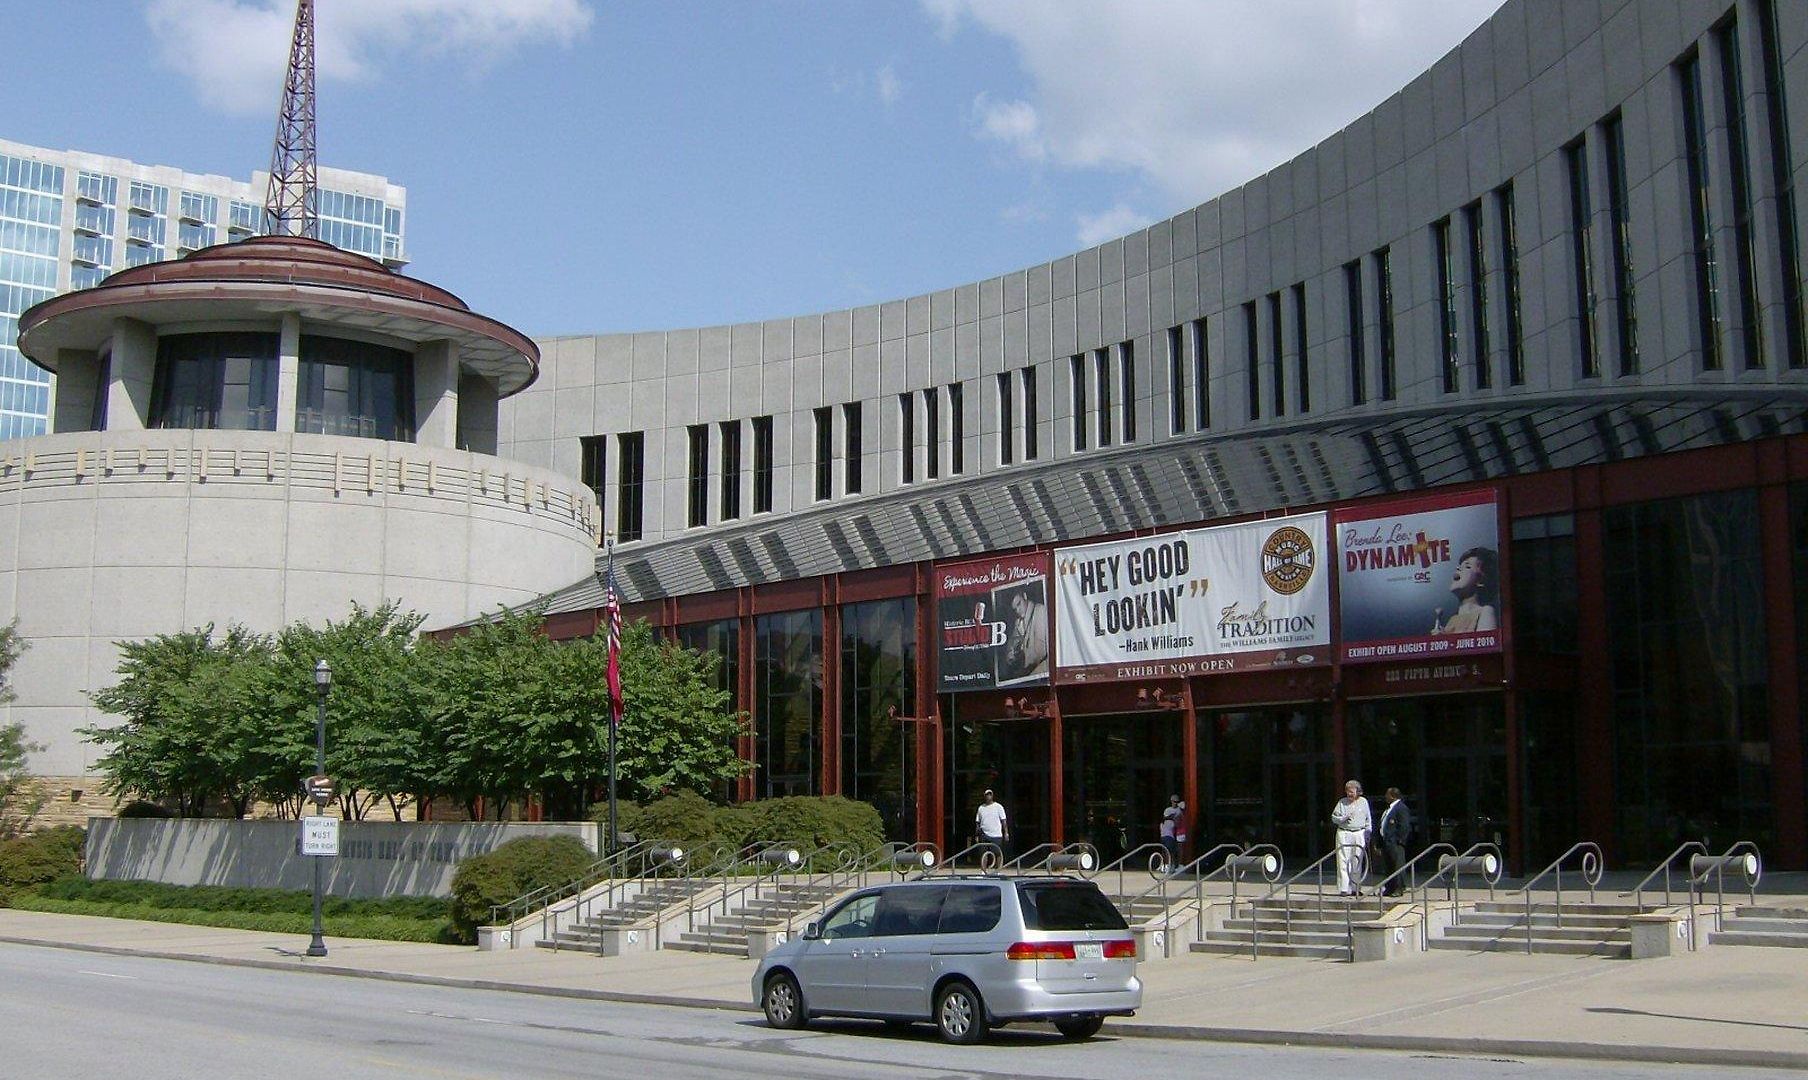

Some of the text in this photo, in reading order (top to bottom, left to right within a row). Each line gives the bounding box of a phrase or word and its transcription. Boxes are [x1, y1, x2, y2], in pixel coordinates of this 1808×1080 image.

[1275, 541, 1301, 554] MUSIC
[1345, 529, 1383, 548] Brenda
[1345, 531, 1451, 573] DYNAMITE
[1127, 540, 1189, 587] GOOD
[943, 563, 1039, 592] Experience the Magic
[990, 621, 1007, 646] B
[1220, 615, 1315, 639] TRADITION
[1151, 636, 1194, 652] Williams
[1232, 637, 1267, 648] WILLIAMS
[1349, 647, 1375, 659] EXHIBIT
[1377, 645, 1396, 657] OPEN
[1398, 641, 1428, 655] AUGUST
[1430, 640, 1449, 652] 2009
[1456, 638, 1475, 650] JUNE
[1477, 636, 1495, 648] 2010
[1117, 665, 1165, 679] EXHIBIT
[1170, 662, 1196, 676] NOW
[1201, 659, 1235, 672] OPEN
[1404, 667, 1430, 680] FIFTH
[312, 831, 330, 839] MUST
